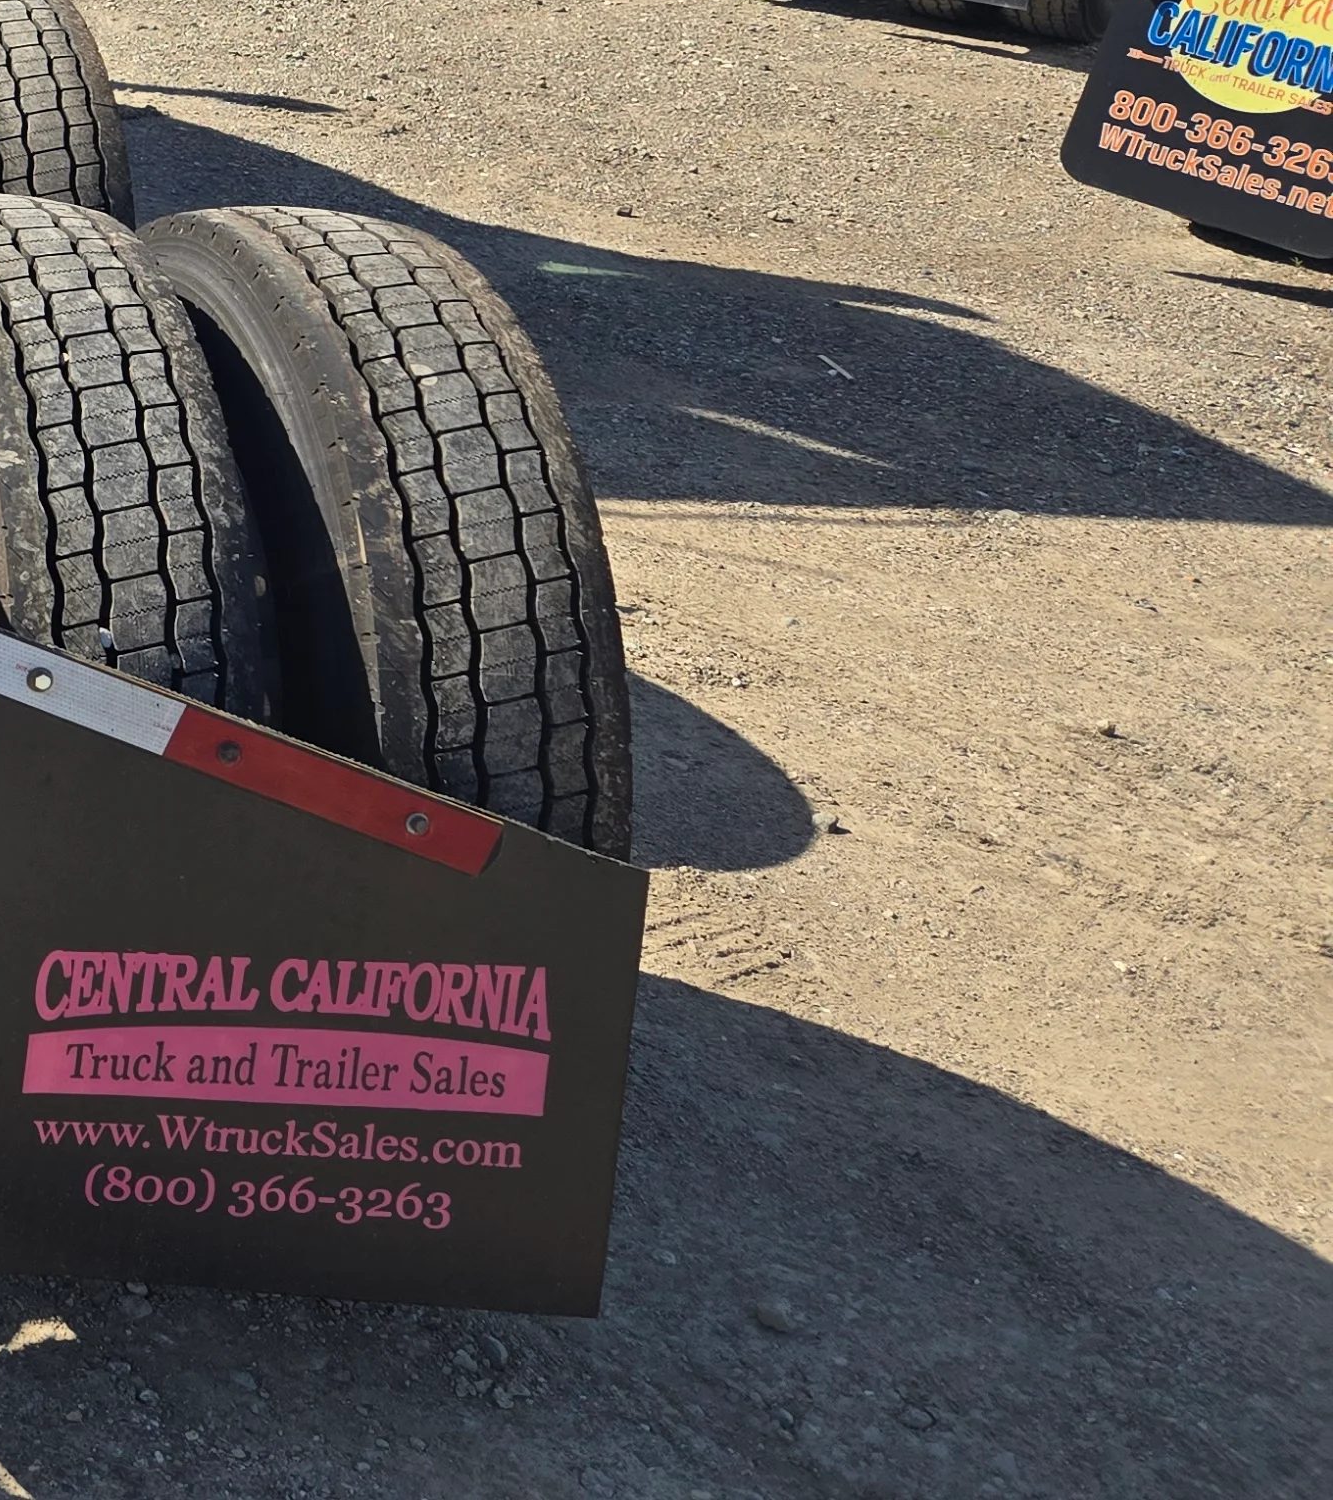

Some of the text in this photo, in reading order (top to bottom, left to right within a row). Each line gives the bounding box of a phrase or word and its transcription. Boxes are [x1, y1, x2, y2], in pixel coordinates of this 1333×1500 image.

[1147, 1, 1333, 95] CALIFORN
[1162, 55, 1333, 116] TRUCK and TRAILER SALES
[1108, 90, 1333, 185] 800-366-326
[34, 948, 552, 1043] CENTRAL CALIFORNIA
[64, 1041, 509, 1100] Truck and Trailer Sales
[32, 1113, 523, 1170] www.WtruckSales.com
[83, 1162, 453, 1231] (800) 366-3263
